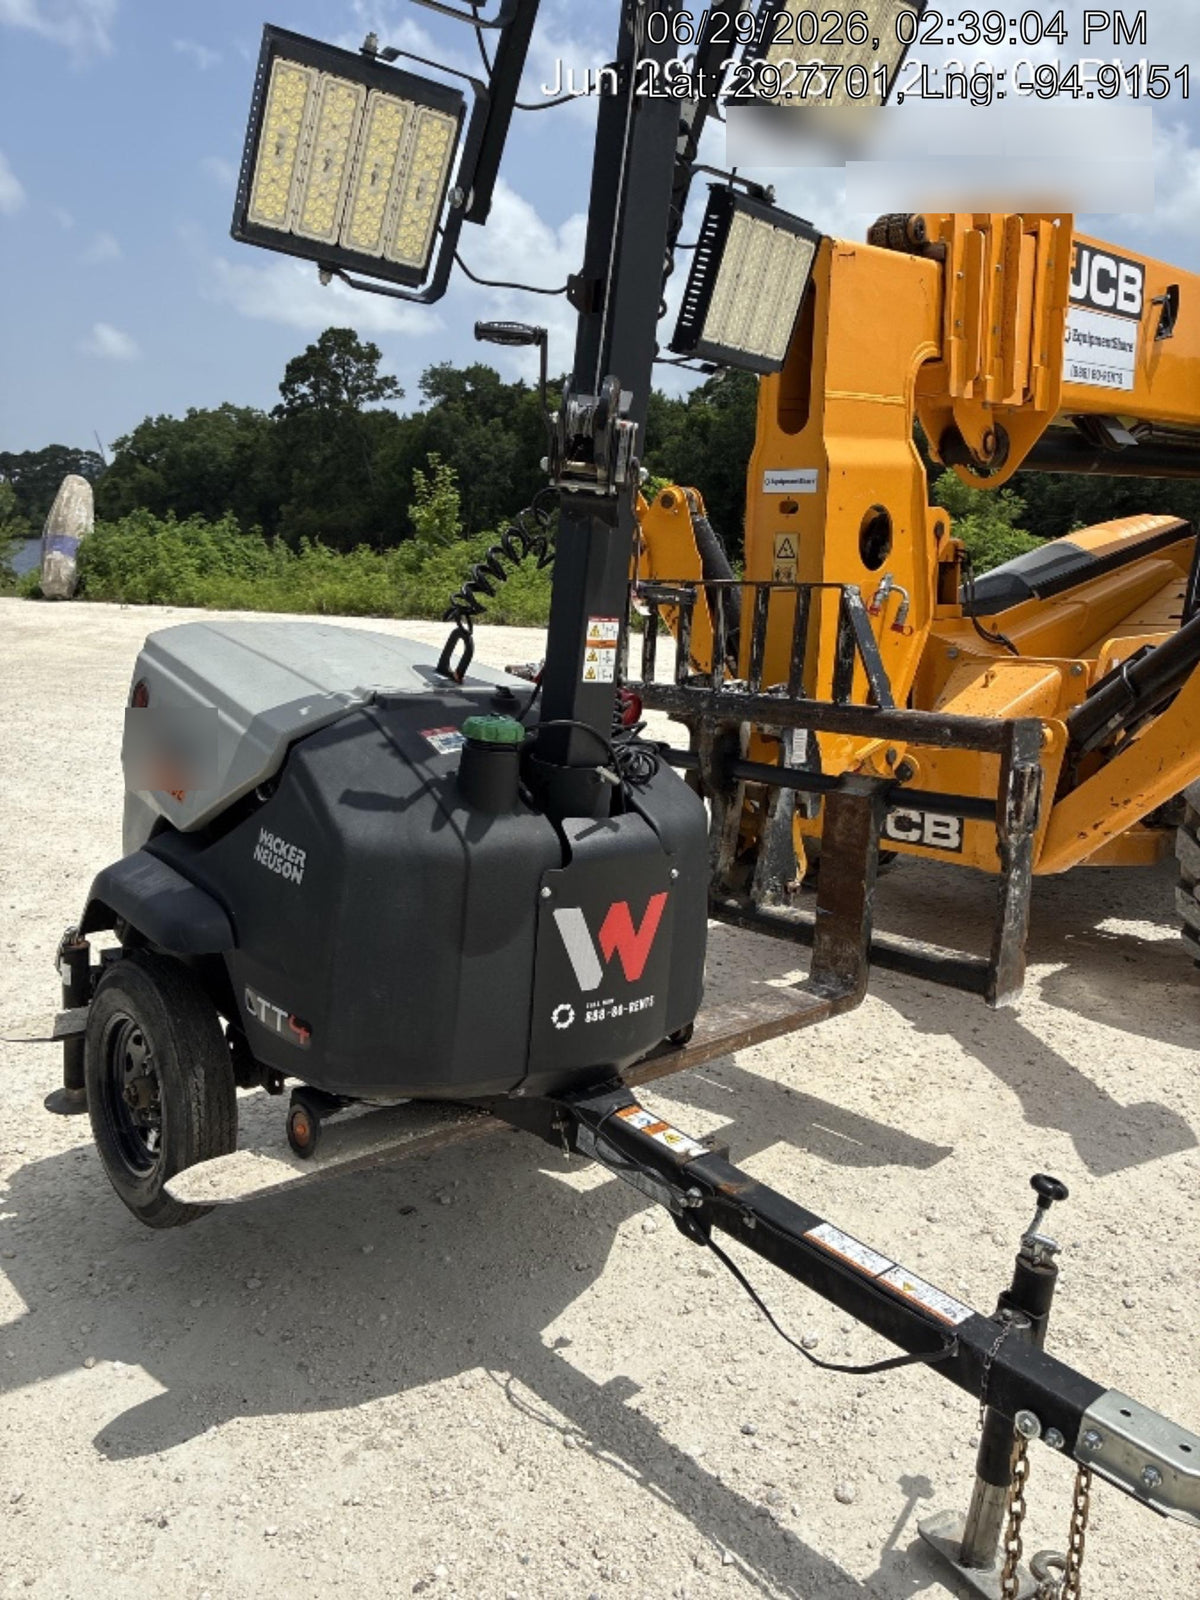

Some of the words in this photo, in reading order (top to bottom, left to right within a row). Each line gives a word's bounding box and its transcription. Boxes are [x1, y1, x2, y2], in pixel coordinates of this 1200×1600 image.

[1069, 250, 1143, 314] JCB
[259, 827, 306, 868] WACKER
[880, 807, 960, 849] CB
[253, 844, 305, 885] NEUSON
